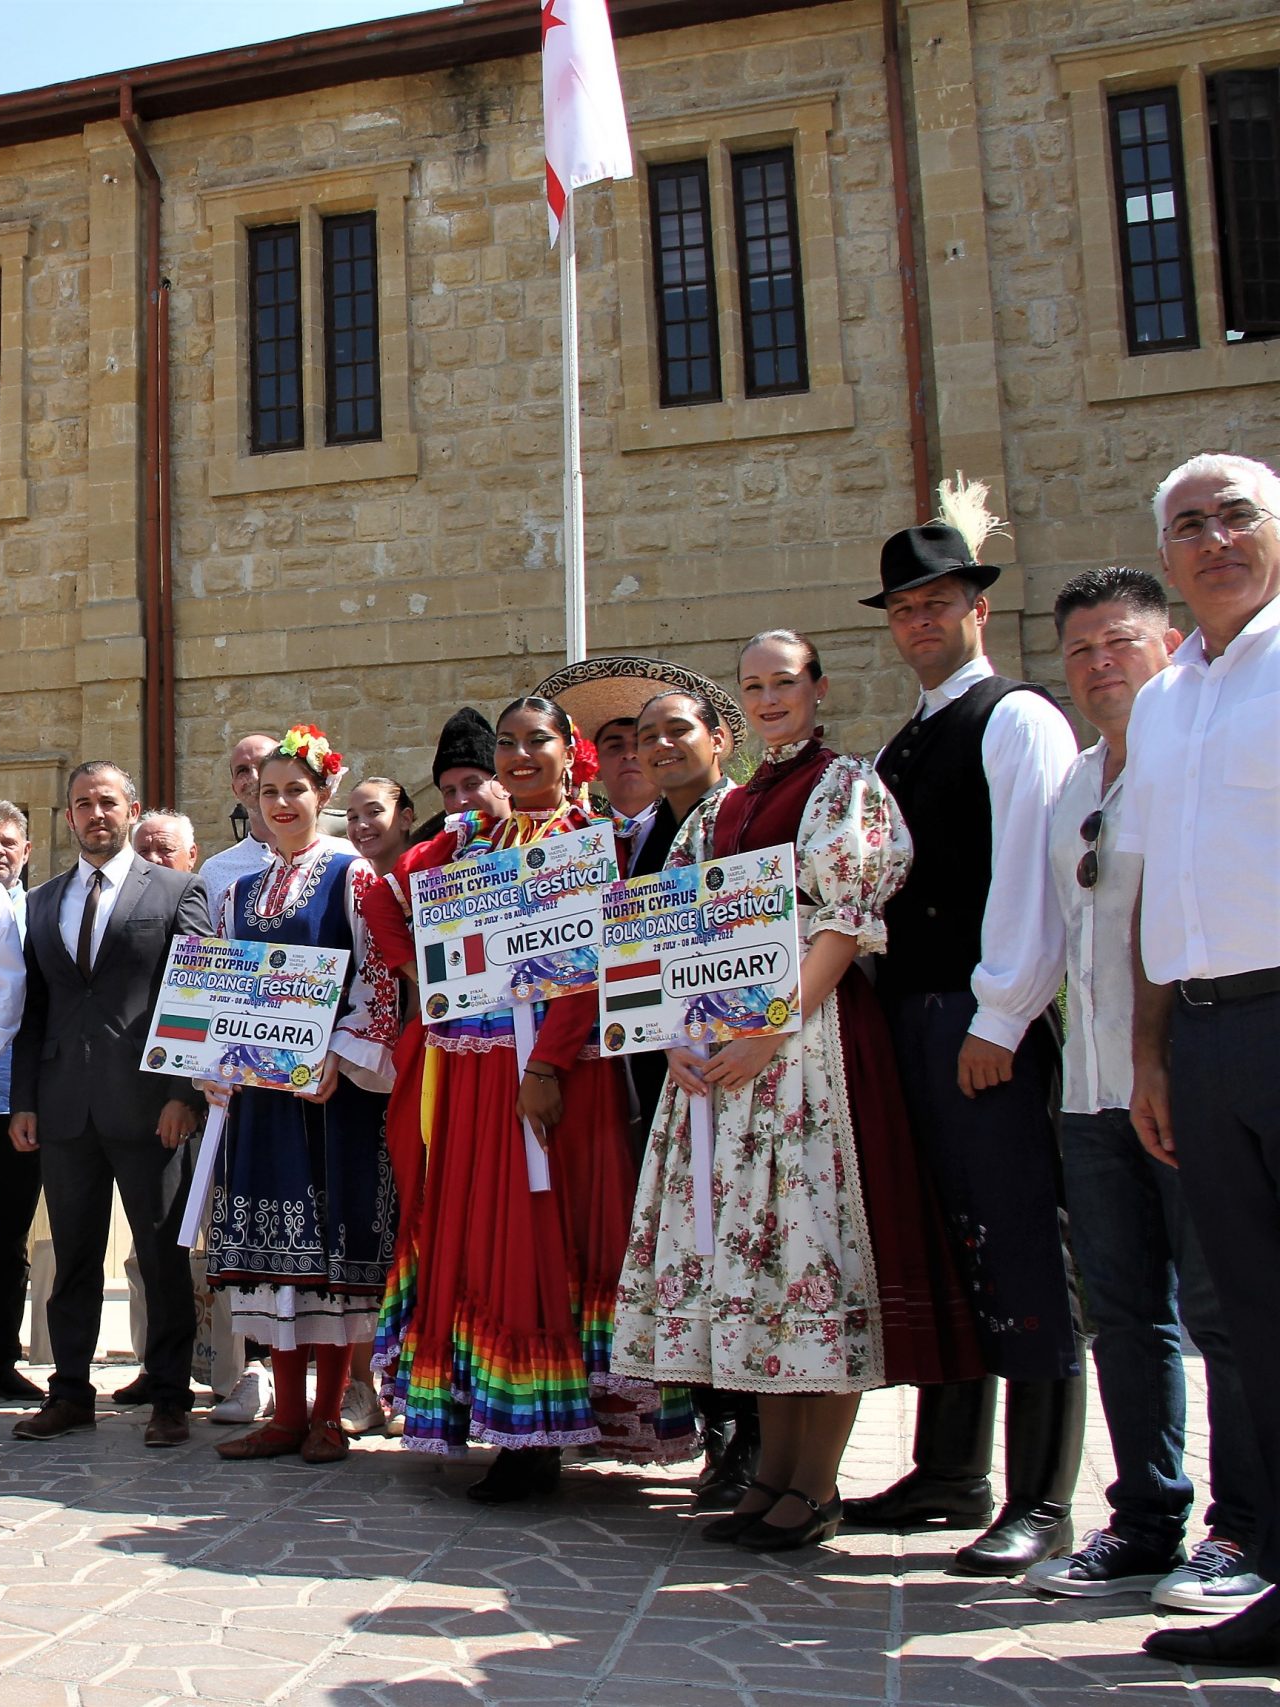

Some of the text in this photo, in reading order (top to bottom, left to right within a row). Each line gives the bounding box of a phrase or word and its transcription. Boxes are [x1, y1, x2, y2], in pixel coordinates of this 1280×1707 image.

[418, 862, 496, 889] INTERNATIONAL
[419, 869, 518, 903] NORTH CYPRUS
[422, 860, 608, 925] FOLK DANCE Festival
[602, 880, 677, 903] INTERNATIONAL
[603, 889, 697, 920] NORTH CYPRUS
[484, 916, 498, 925] JULY
[543, 902, 558, 911] 2022
[605, 888, 784, 944] FOLK DANCE Festival
[176, 944, 244, 957] INTERNATIONAL
[507, 920, 593, 955] MEXICO
[663, 942, 676, 950] JULY
[718, 931, 733, 940] 2022
[173, 954, 211, 967] NORTH
[215, 959, 259, 972] CYPRUS
[672, 952, 778, 989] HUNGARY
[170, 970, 333, 1000] FOLK DANCE Festival
[215, 1018, 314, 1045] BULGARIA
